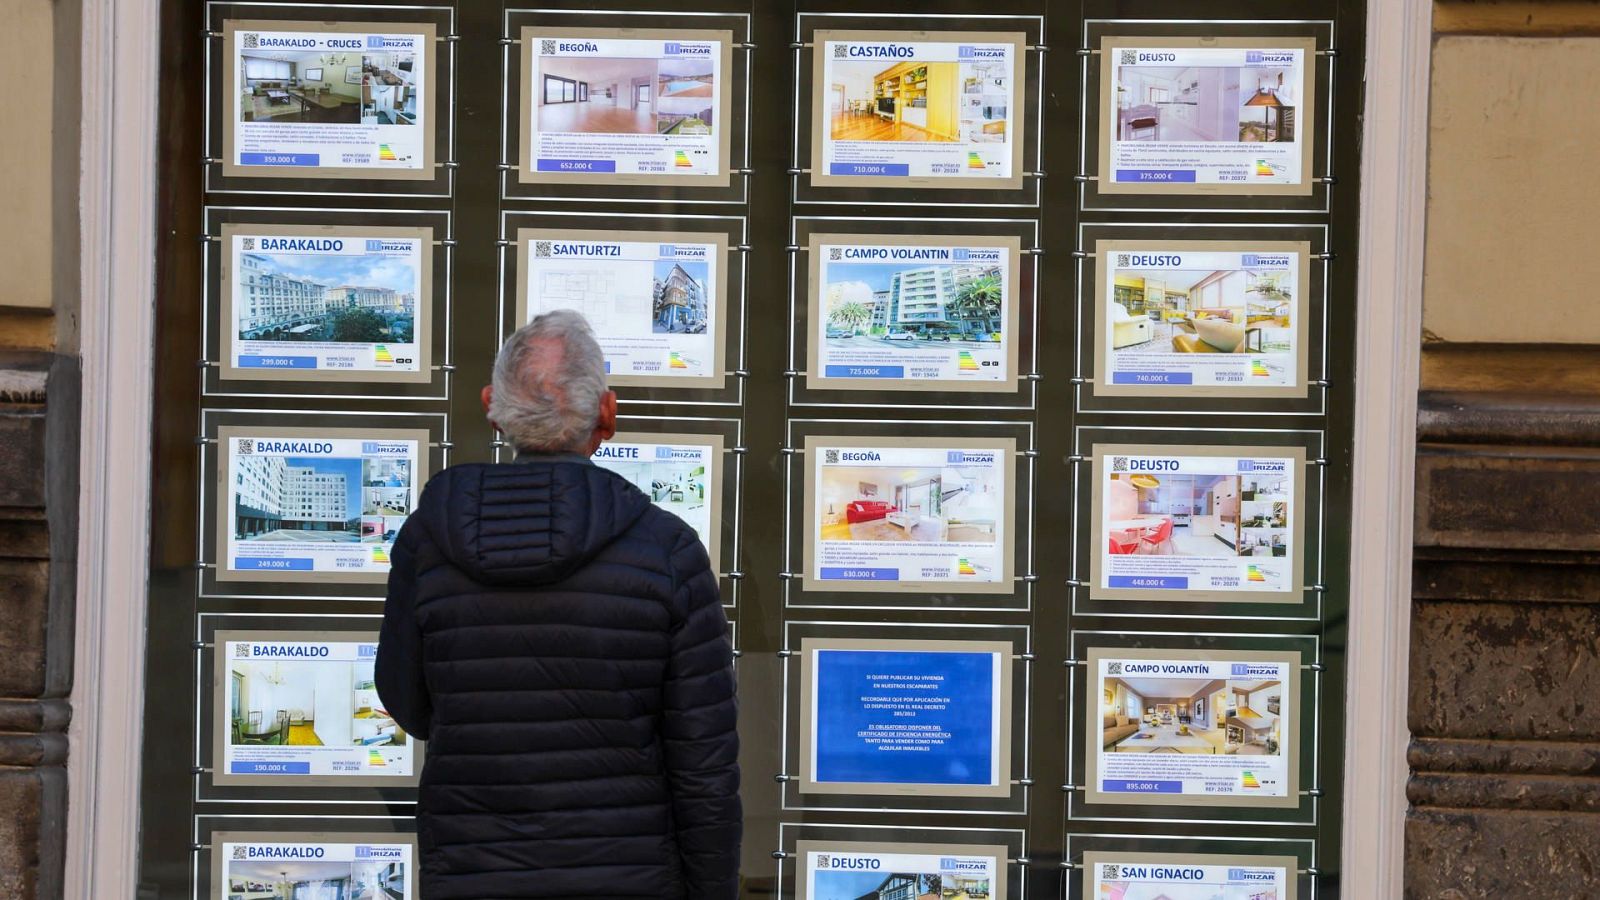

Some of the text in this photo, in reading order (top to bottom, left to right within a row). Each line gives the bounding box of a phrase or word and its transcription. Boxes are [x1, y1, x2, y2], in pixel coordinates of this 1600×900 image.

[260, 38, 362, 48] BARAKALDO CRUCES
[559, 42, 598, 52] BEGOÑA
[849, 45, 914, 57] CASTAÑOS
[1139, 54, 1176, 62] DEUSTO
[262, 239, 342, 252] BARAKALDO
[554, 245, 620, 256] SANTURTZI
[845, 249, 948, 259] CAMPO VOLANTIN
[1132, 256, 1181, 266] DEUSTO
[258, 442, 332, 453] BARAKALDO
[594, 447, 638, 458] GALETE
[842, 452, 880, 461] BEGOÑA
[1131, 460, 1179, 471] DEUSTO
[253, 646, 328, 656] BARAKALDO
[1125, 664, 1209, 674] CAMPO VOLANTÍN
[249, 847, 324, 857] BARAKALDO
[832, 858, 880, 869] DEUSTO
[1122, 868, 1204, 880] SAN IGNACIO
